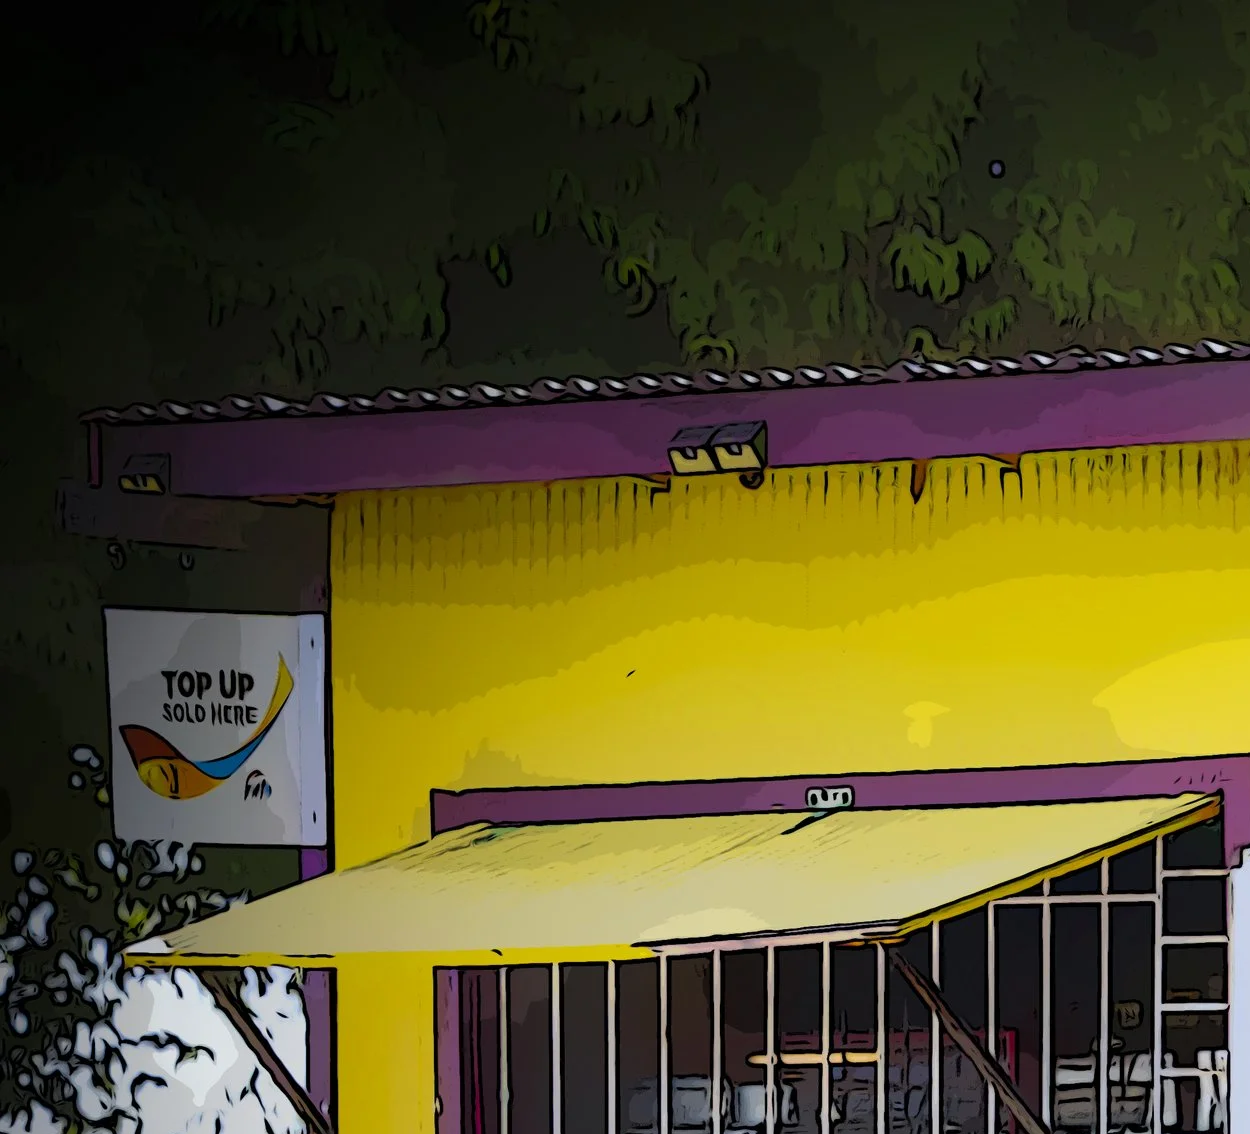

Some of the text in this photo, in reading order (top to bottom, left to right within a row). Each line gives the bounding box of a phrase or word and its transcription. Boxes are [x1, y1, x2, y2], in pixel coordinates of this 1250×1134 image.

[161, 669, 254, 700] TOP UP
[162, 702, 206, 723] SOLD
